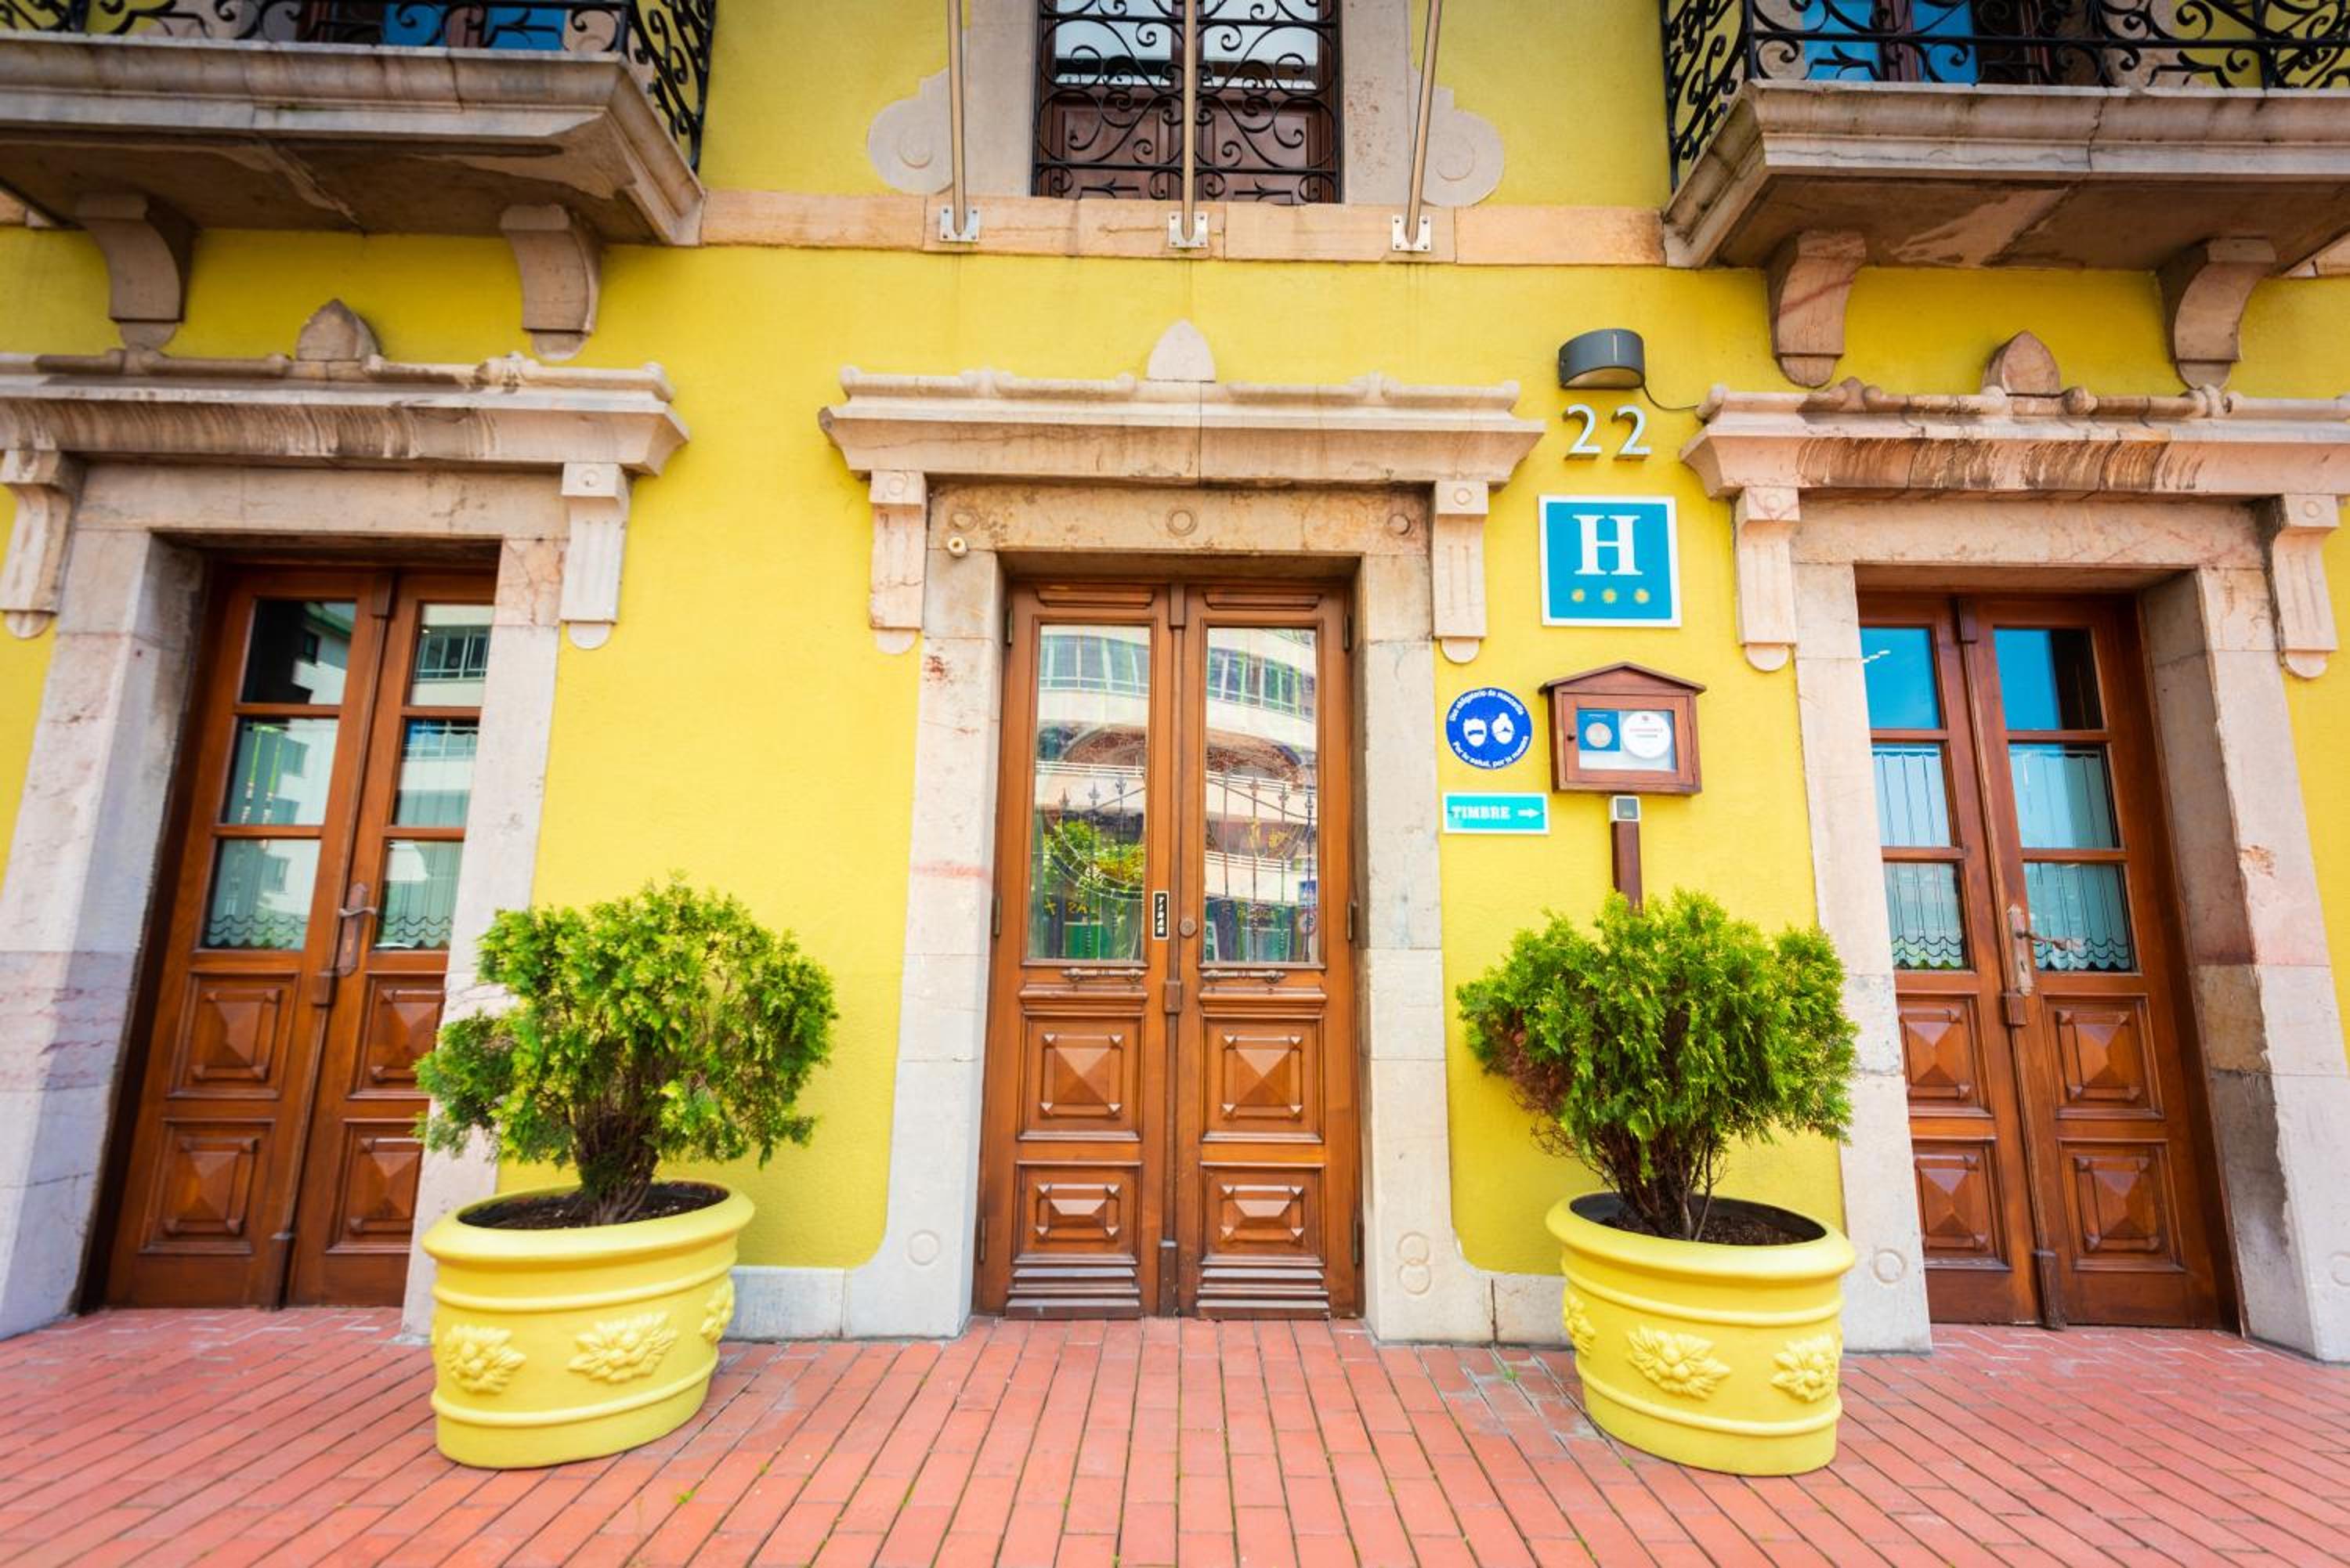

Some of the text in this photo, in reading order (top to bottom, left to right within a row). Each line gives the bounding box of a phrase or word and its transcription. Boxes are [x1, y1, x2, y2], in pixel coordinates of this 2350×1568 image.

[1564, 403, 1652, 458] 22
[1572, 515, 1643, 576] H
[1448, 708, 1459, 721] Uso
[1456, 690, 1487, 710] obligatorio
[1451, 805, 1511, 820] TIMBRE
